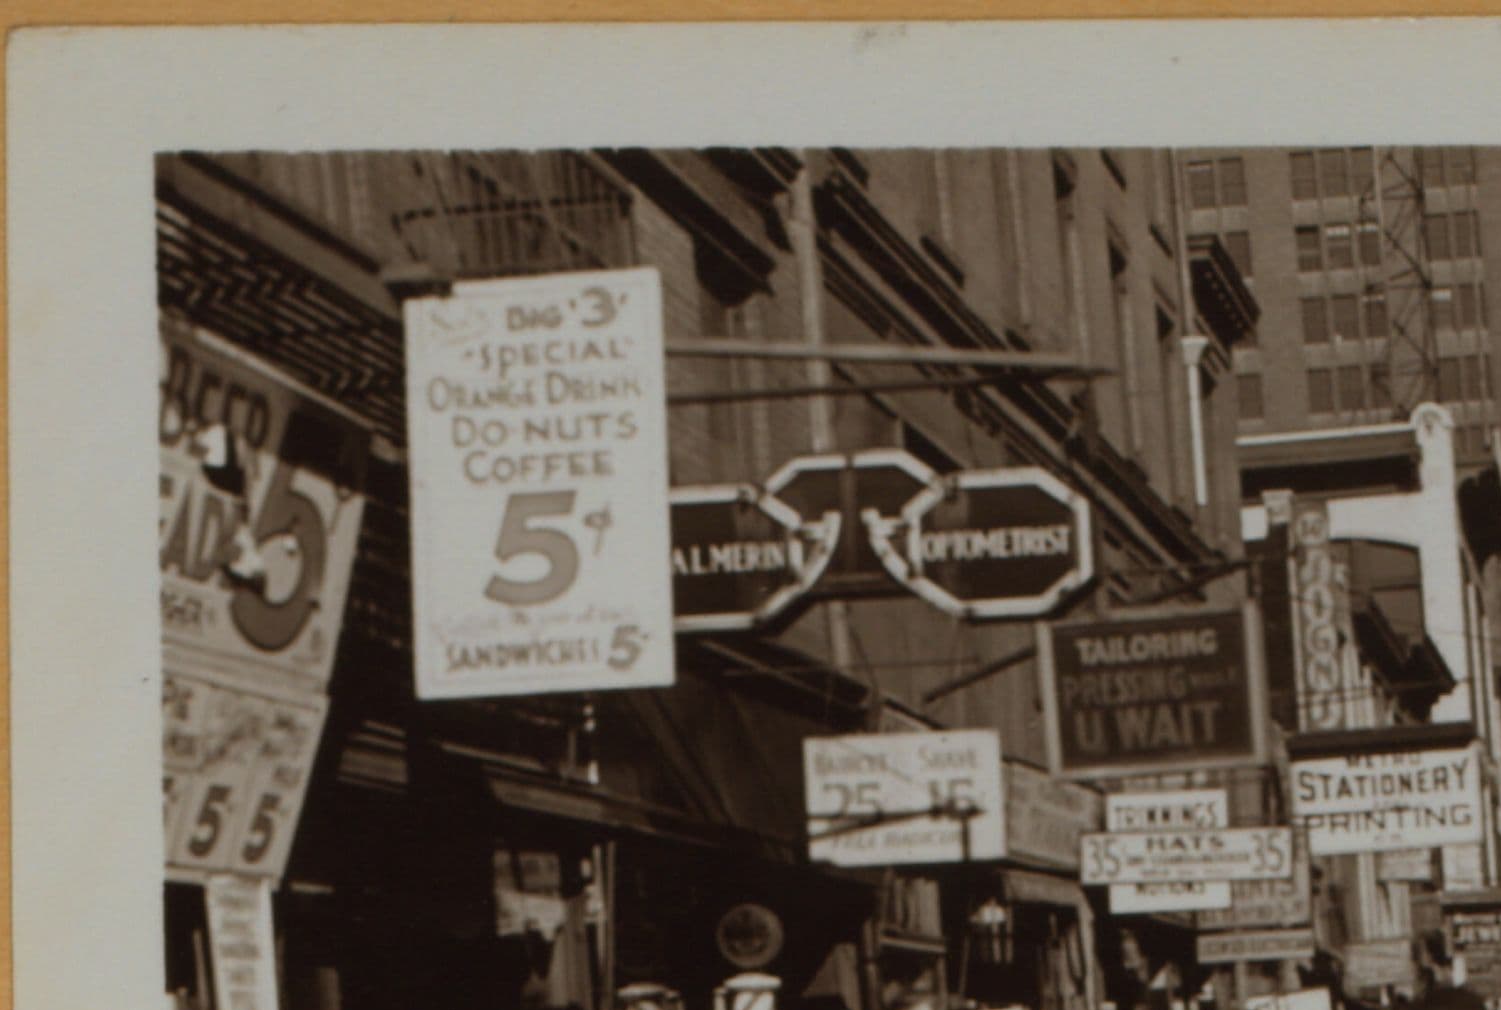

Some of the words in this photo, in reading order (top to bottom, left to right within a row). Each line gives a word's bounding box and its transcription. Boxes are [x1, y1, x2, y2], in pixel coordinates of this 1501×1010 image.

[506, 305, 563, 332] BIG
[428, 375, 536, 412] ORANGE
[463, 449, 615, 484] COFFEE
[921, 525, 1072, 563] OPTOMETRIST
[1075, 629, 1218, 666] TAILORING
[1062, 667, 1187, 708] PRESSING
[1074, 710, 1106, 752] U
[1117, 701, 1221, 749] WAIT
[1299, 758, 1469, 801] STATIONERY
[1302, 803, 1472, 834] PRINTING
[1146, 836, 1224, 852] HATS
